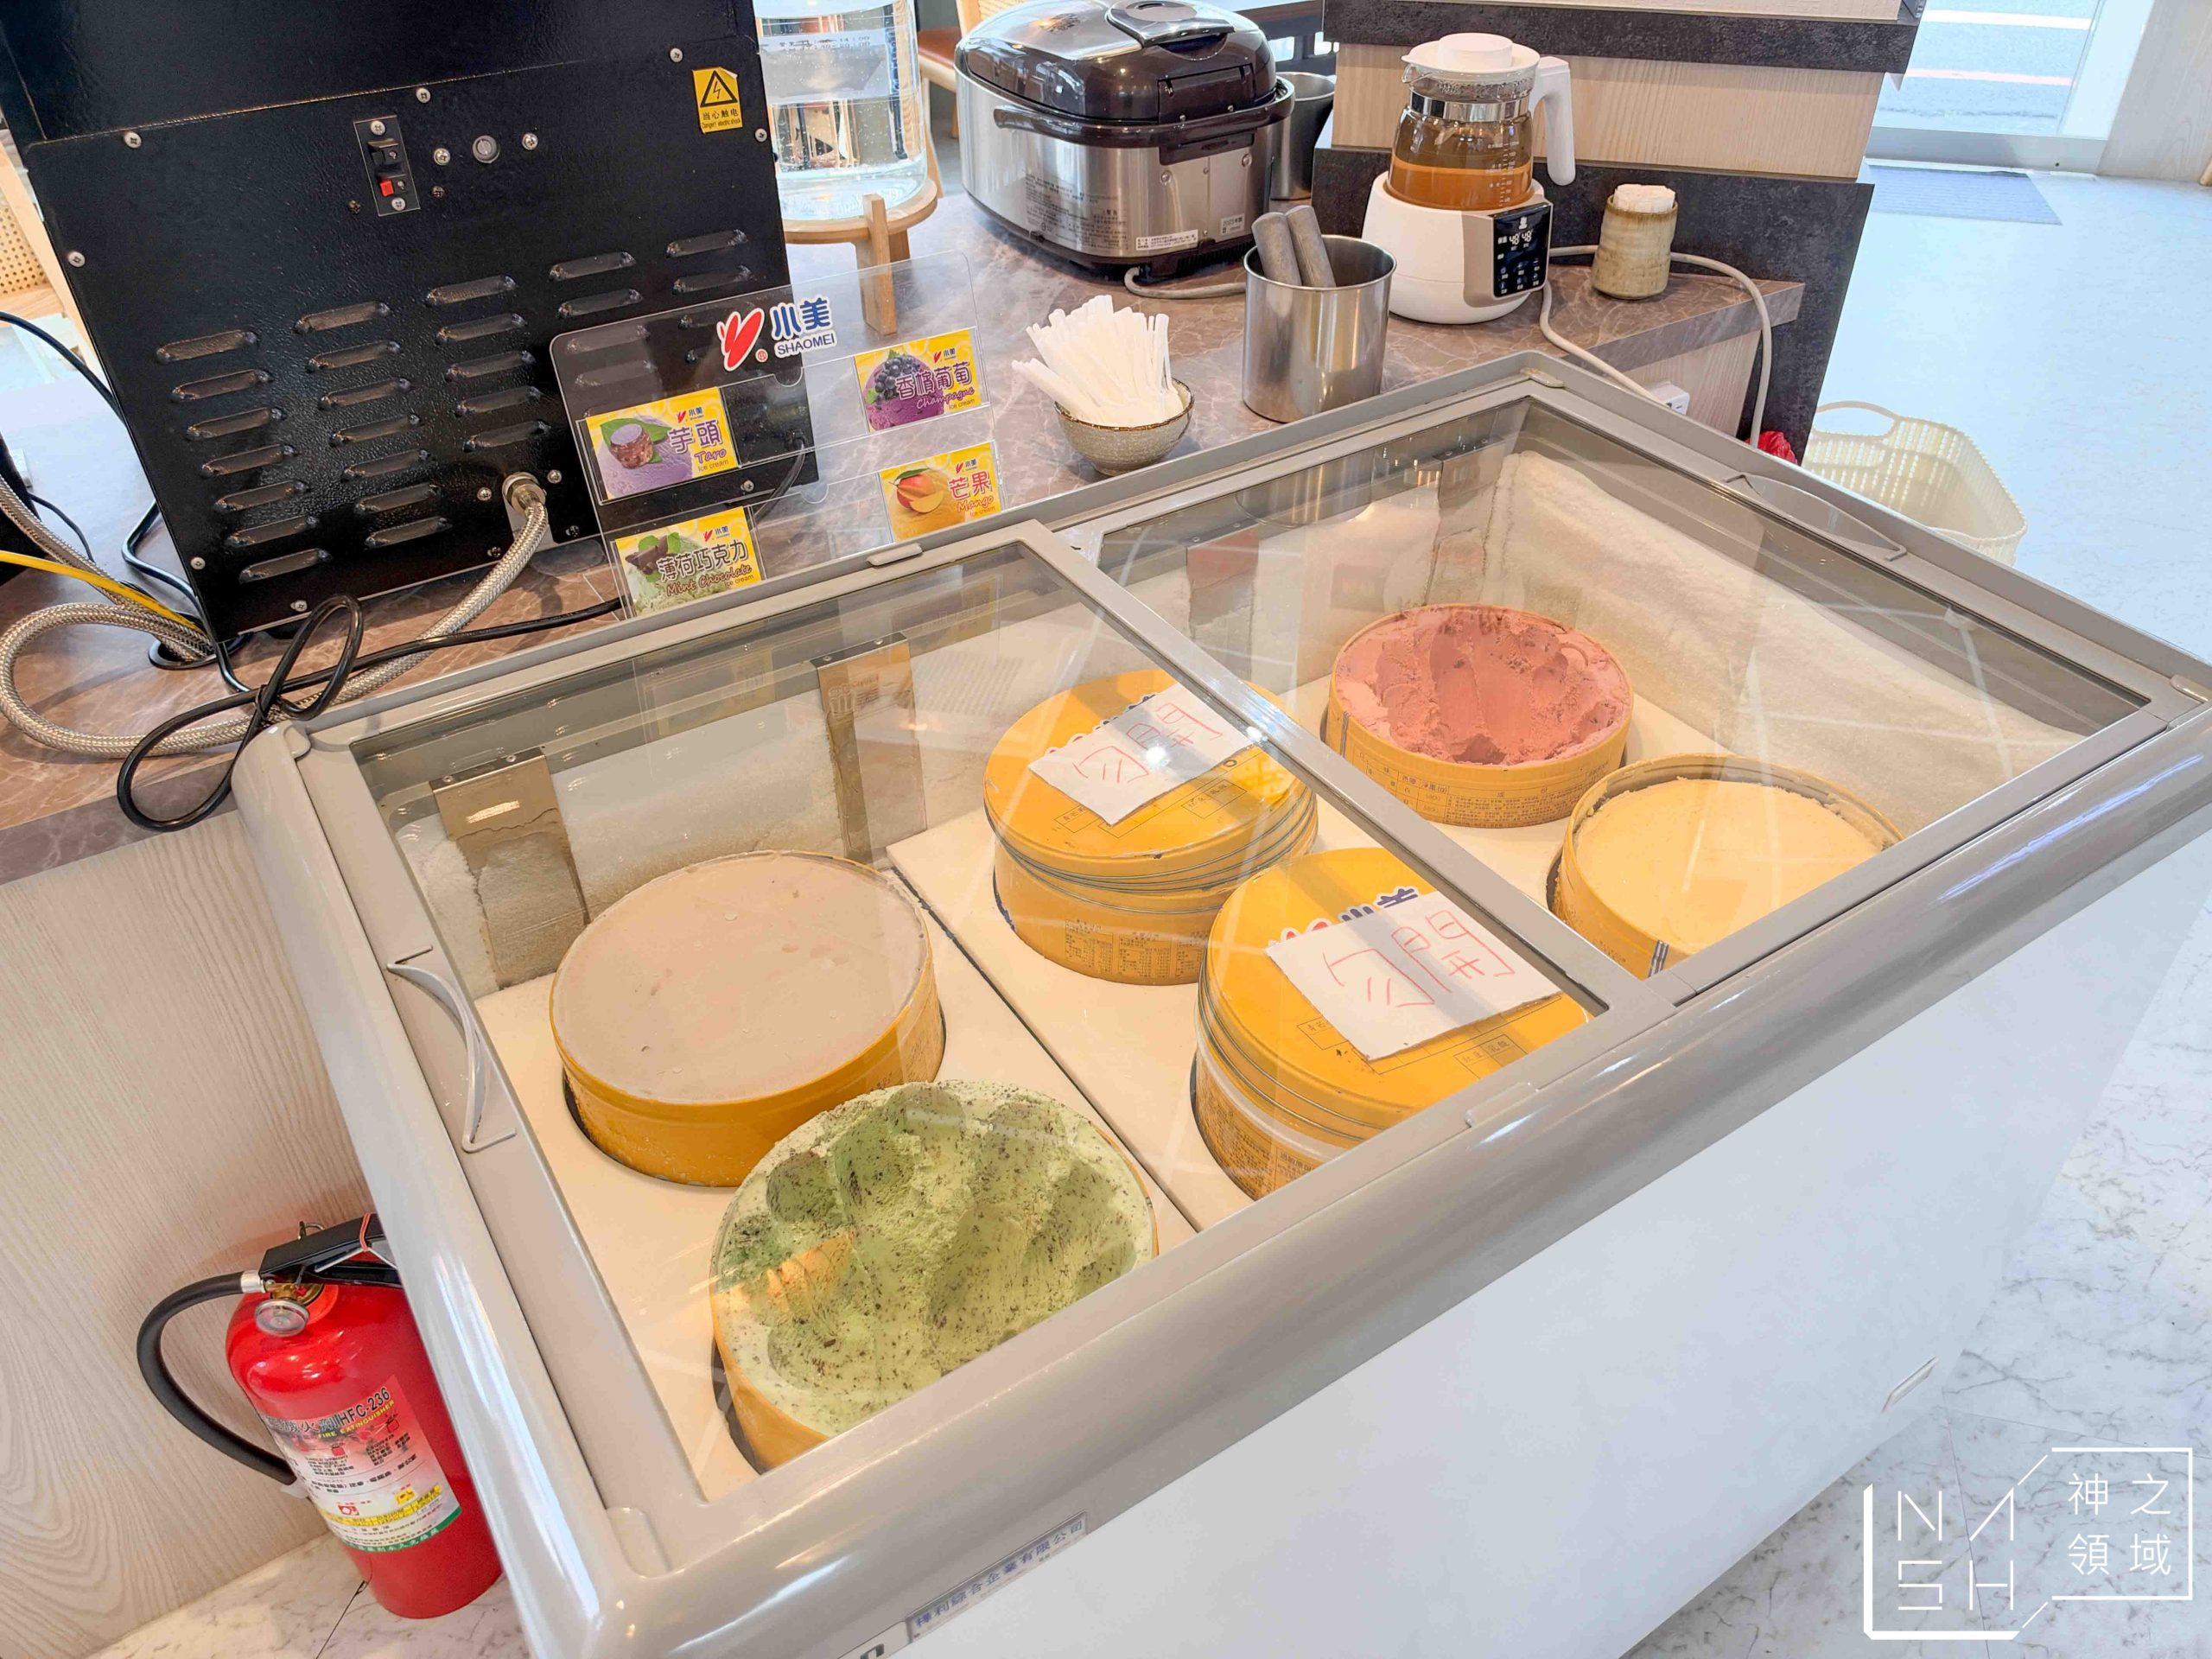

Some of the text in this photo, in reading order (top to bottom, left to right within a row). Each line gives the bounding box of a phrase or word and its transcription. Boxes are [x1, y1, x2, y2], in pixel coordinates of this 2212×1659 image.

[772, 297, 831, 338] 小美
[778, 333, 836, 355] SHAOMEI
[895, 360, 972, 400] 香檳葡萄
[917, 387, 975, 409] Champagne
[668, 419, 723, 454] 芋頭
[694, 448, 727, 464] Taro
[709, 459, 729, 470] cream
[948, 471, 992, 500] 芒果
[957, 495, 995, 512] Mango
[656, 539, 748, 583] 薄荷巧克力
[666, 563, 753, 597] Mint Chocolate
[1322, 909, 1516, 1008] 勿開
[340, 1399, 395, 1434] EXTINGUISHER
